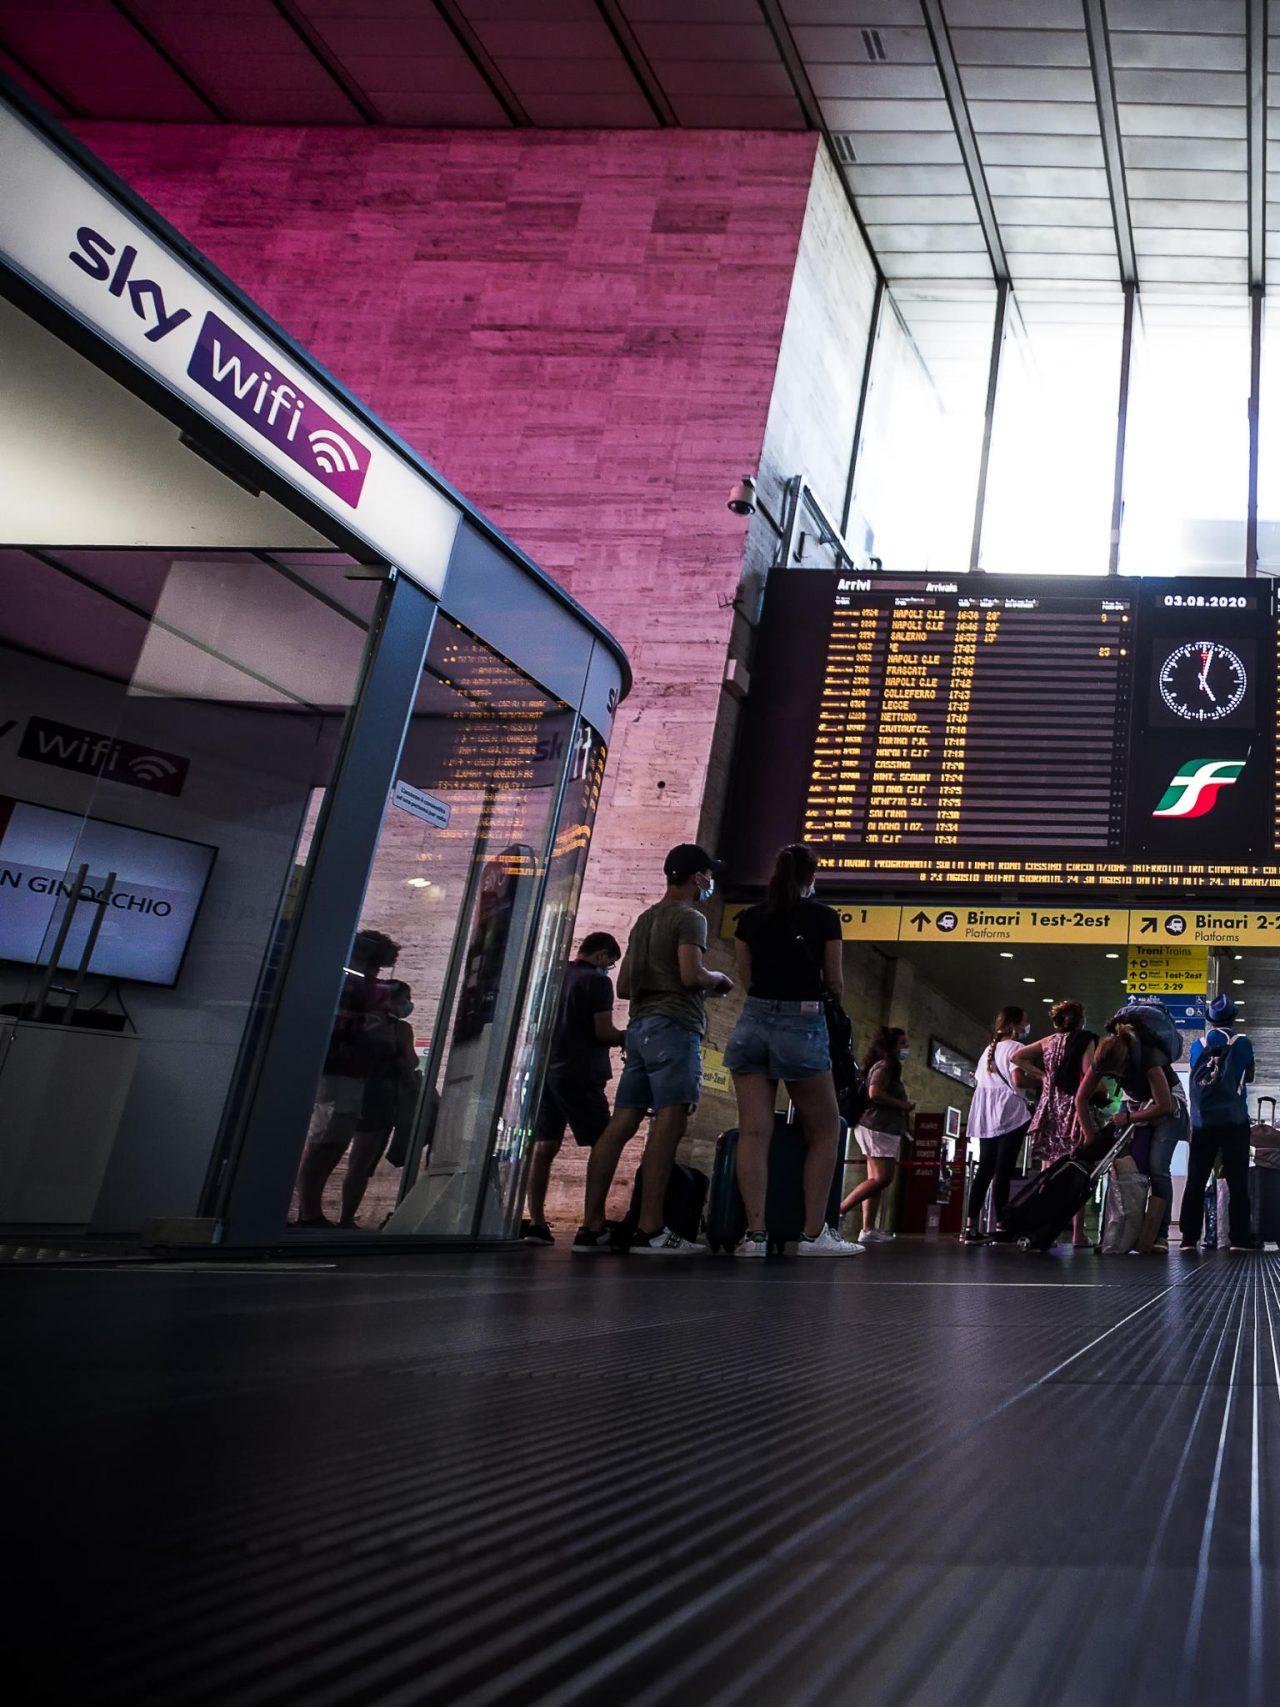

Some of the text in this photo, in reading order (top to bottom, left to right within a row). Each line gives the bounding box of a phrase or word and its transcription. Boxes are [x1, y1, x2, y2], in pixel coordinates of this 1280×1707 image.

[69, 226, 192, 342] sky
[837, 578, 958, 593] Arrivi Arrivals
[1164, 595, 1247, 608] 03.08.2020
[894, 610, 923, 618] NAPOLI
[892, 621, 921, 630] NAPOLI
[891, 632, 926, 641] SALERNO
[888, 655, 918, 663] NAPOLI
[887, 666, 926, 675] FRASCATI
[886, 678, 915, 686] NAPOLI
[884, 689, 935, 698] COLLEFERRO
[883, 701, 908, 710] LECCE
[881, 713, 916, 721] NETTUNO
[837, 910, 867, 923] io 1
[967, 912, 1110, 927] Binari 1est-2est
[1195, 915, 1248, 929] Binari
[965, 928, 1010, 939] Platforms
[1195, 931, 1240, 942] Platforms
[1137, 947, 1192, 955] Treni Trains
